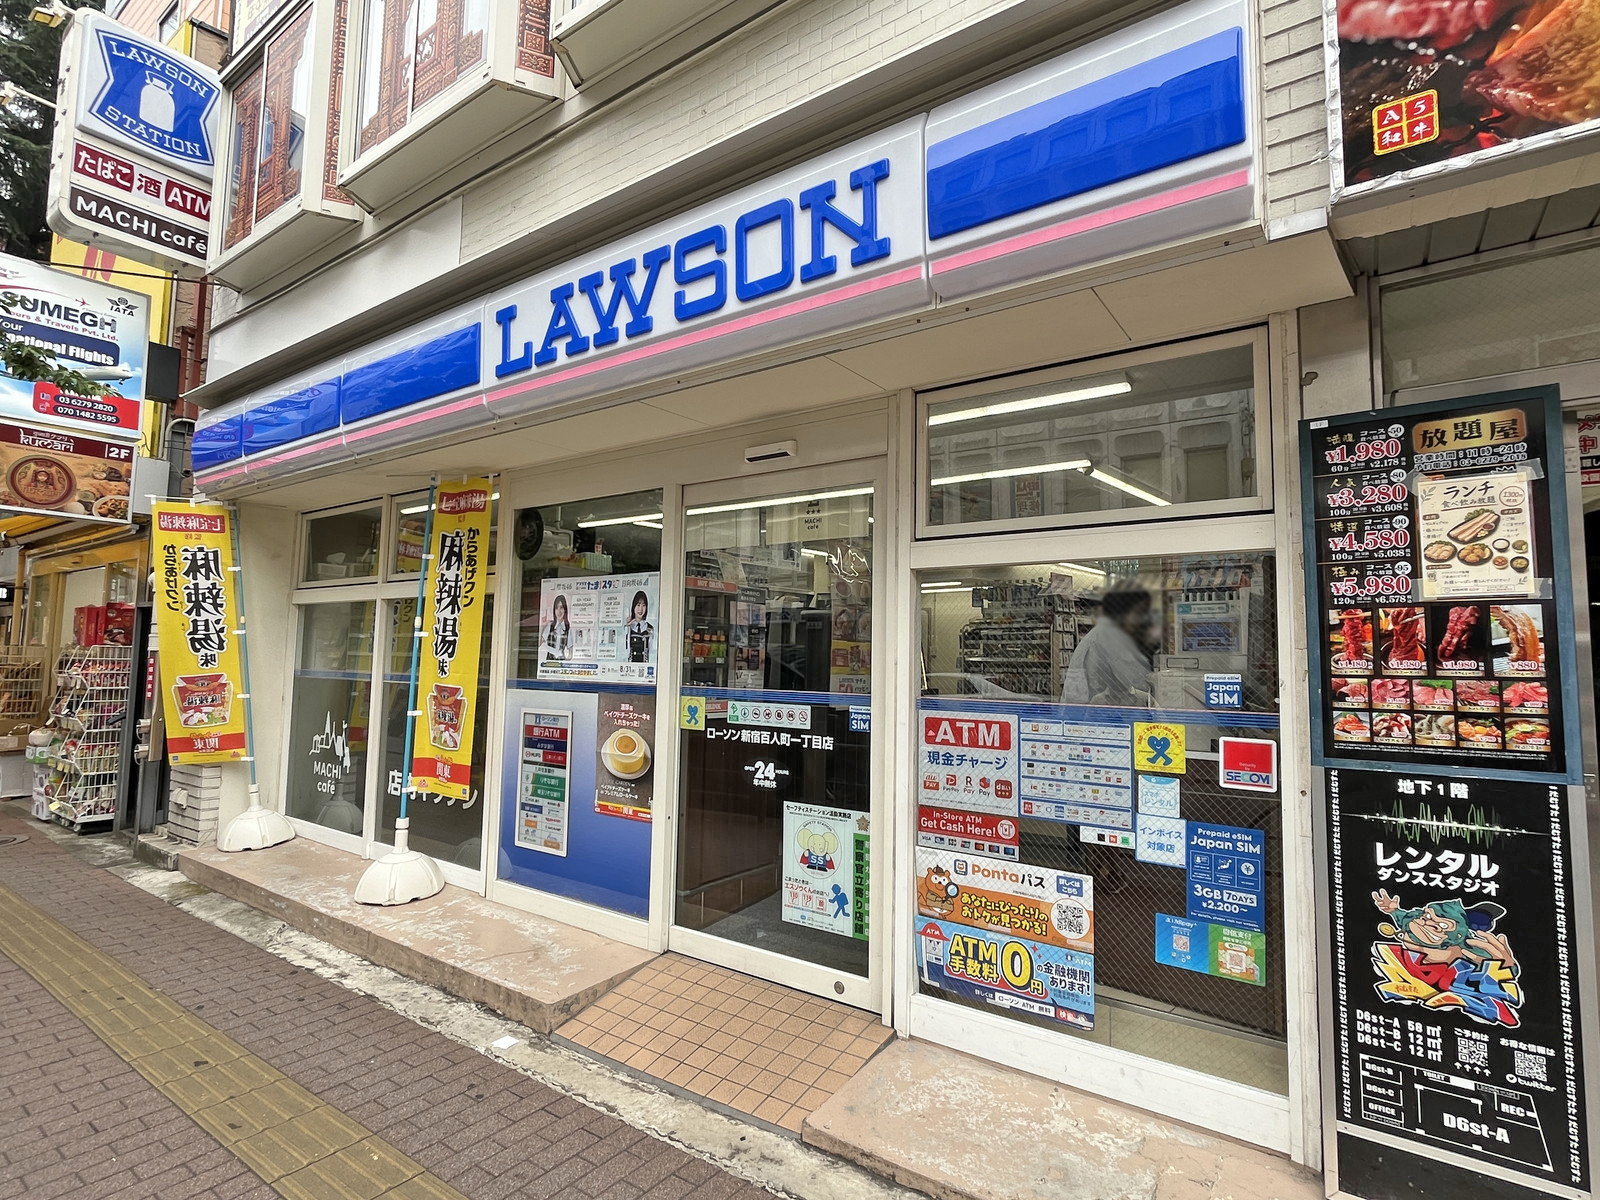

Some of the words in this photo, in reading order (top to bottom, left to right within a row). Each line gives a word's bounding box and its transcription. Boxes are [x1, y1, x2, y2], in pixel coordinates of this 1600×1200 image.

[110, 41, 209, 98] LAWSON
[105, 105, 203, 157] STATION
[77, 151, 132, 188] たばこ
[137, 173, 162, 199] 酒
[77, 195, 157, 238] MACHI
[160, 230, 207, 254] café
[496, 158, 891, 378] LAWSON
[110, 305, 135, 317] IATA
[46, 319, 79, 332] Travels
[102, 333, 119, 341] Ltd.
[69, 345, 115, 365] Flights
[59, 396, 71, 404] 03
[72, 398, 92, 408] 6279
[93, 401, 114, 412] 2820
[58, 406, 73, 415] 070
[76, 409, 96, 419] 1482
[97, 412, 117, 423] 5595
[20, 428, 75, 453] kumari
[1360, 428, 1386, 437] コース
[1420, 418, 1520, 449] 放題屋
[109, 447, 131, 459] 2F
[1362, 472, 1388, 480] コース
[1443, 481, 1495, 500] ランチ
[1364, 517, 1390, 525] コース
[462, 526, 480, 608] からあげクン
[1207, 683, 1240, 692] Japan
[1209, 692, 1238, 705] SIM
[533, 727, 560, 738] 銀行ATM
[851, 720, 869, 730] SIM
[935, 720, 1000, 747] ATM
[706, 727, 834, 751] ローソン新宿百人町一丁目店
[313, 761, 341, 780] MACHI
[754, 760, 776, 780] 24
[927, 751, 1009, 771] 現金チャージ
[317, 780, 336, 795] café
[1226, 771, 1270, 785] SECOM
[979, 789, 991, 797] Pay
[1144, 798, 1174, 807] レンタル
[933, 810, 964, 822] In-Store
[966, 815, 982, 824] ATM
[921, 817, 938, 829] Get
[940, 820, 964, 833] Cash
[967, 823, 996, 838] Here!
[1140, 827, 1183, 840] インボイス
[1198, 828, 1231, 840] Prepaid
[1232, 832, 1252, 842] eSIM
[1146, 840, 1175, 854] 対象店
[1190, 835, 1233, 851] Japan
[1236, 842, 1261, 855] SIM
[810, 855, 824, 865] SS
[1375, 842, 1499, 879] レンタル
[1062, 886, 1078, 894] こちら
[1377, 867, 1500, 897] ダンススタジオ
[1194, 884, 1222, 900] 3GB
[1225, 892, 1255, 904] 7DAYS
[961, 892, 1049, 922] あなたにぴったりの
[962, 906, 1048, 936] おトクが見つかる!
[949, 934, 998, 964] ATM
[949, 955, 999, 983] 手数料
[1037, 961, 1091, 983] の金融機関
[1049, 975, 1091, 996] あります!
[998, 996, 1020, 1006] ローソン
[1021, 1002, 1035, 1011] ATM
[1356, 1008, 1401, 1029] D6st-A
[1407, 1020, 1423, 1033] 58
[1356, 1020, 1401, 1040] D6st-B
[1408, 1033, 1424, 1045] 12
[1454, 1027, 1490, 1041] ご予約は
[1357, 1032, 1402, 1052] D6st-C
[1409, 1044, 1425, 1057] 12
[1517, 1077, 1557, 1093] twitter
[1368, 1102, 1397, 1116] OFFICE
[1500, 1102, 1526, 1117] REC
[1443, 1112, 1511, 1145] D6st-A
